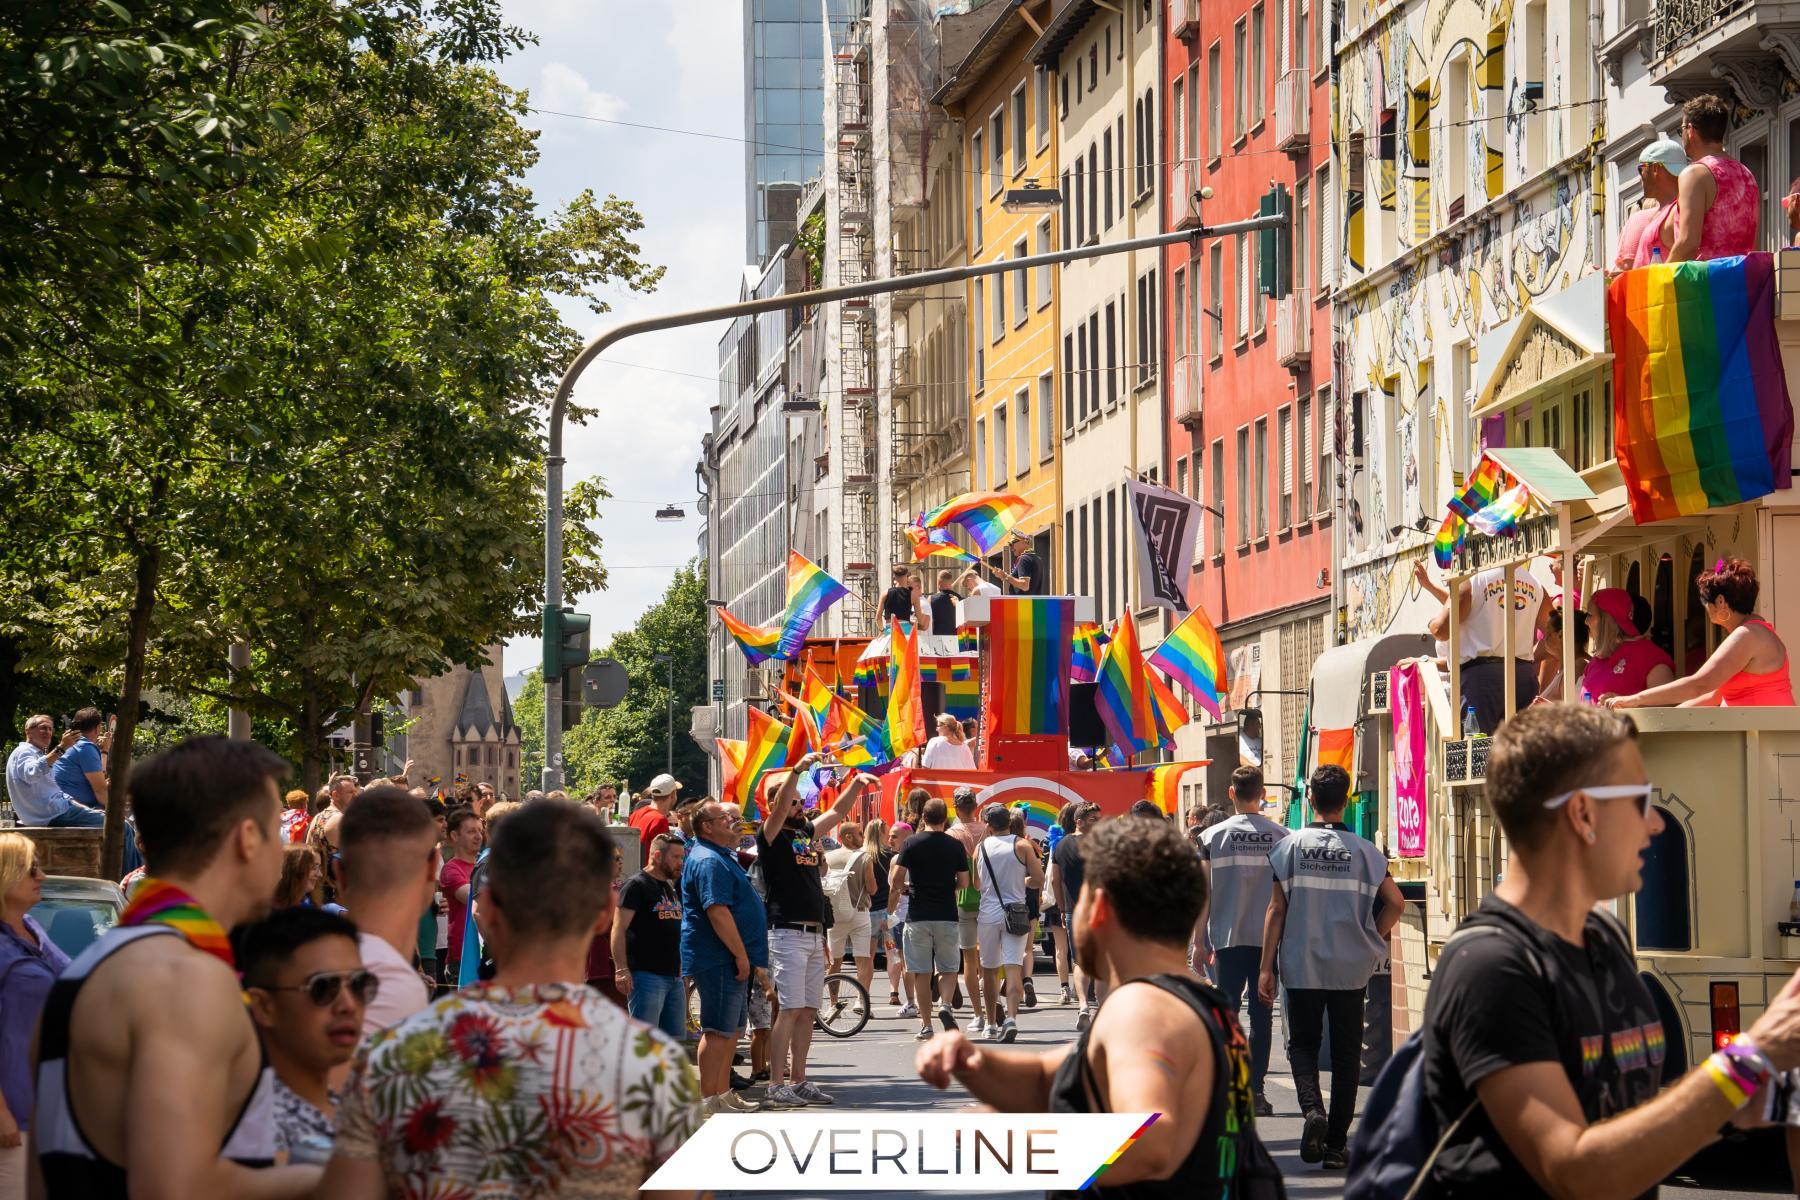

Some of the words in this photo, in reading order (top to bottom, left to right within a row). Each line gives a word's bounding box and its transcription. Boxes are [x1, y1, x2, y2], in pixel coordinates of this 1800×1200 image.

[1230, 832, 1272, 842] WGG
[796, 854, 818, 865] BERLI
[1301, 848, 1351, 861] WGG
[1300, 862, 1350, 873] Sicherheit
[658, 911, 682, 919] BERLI
